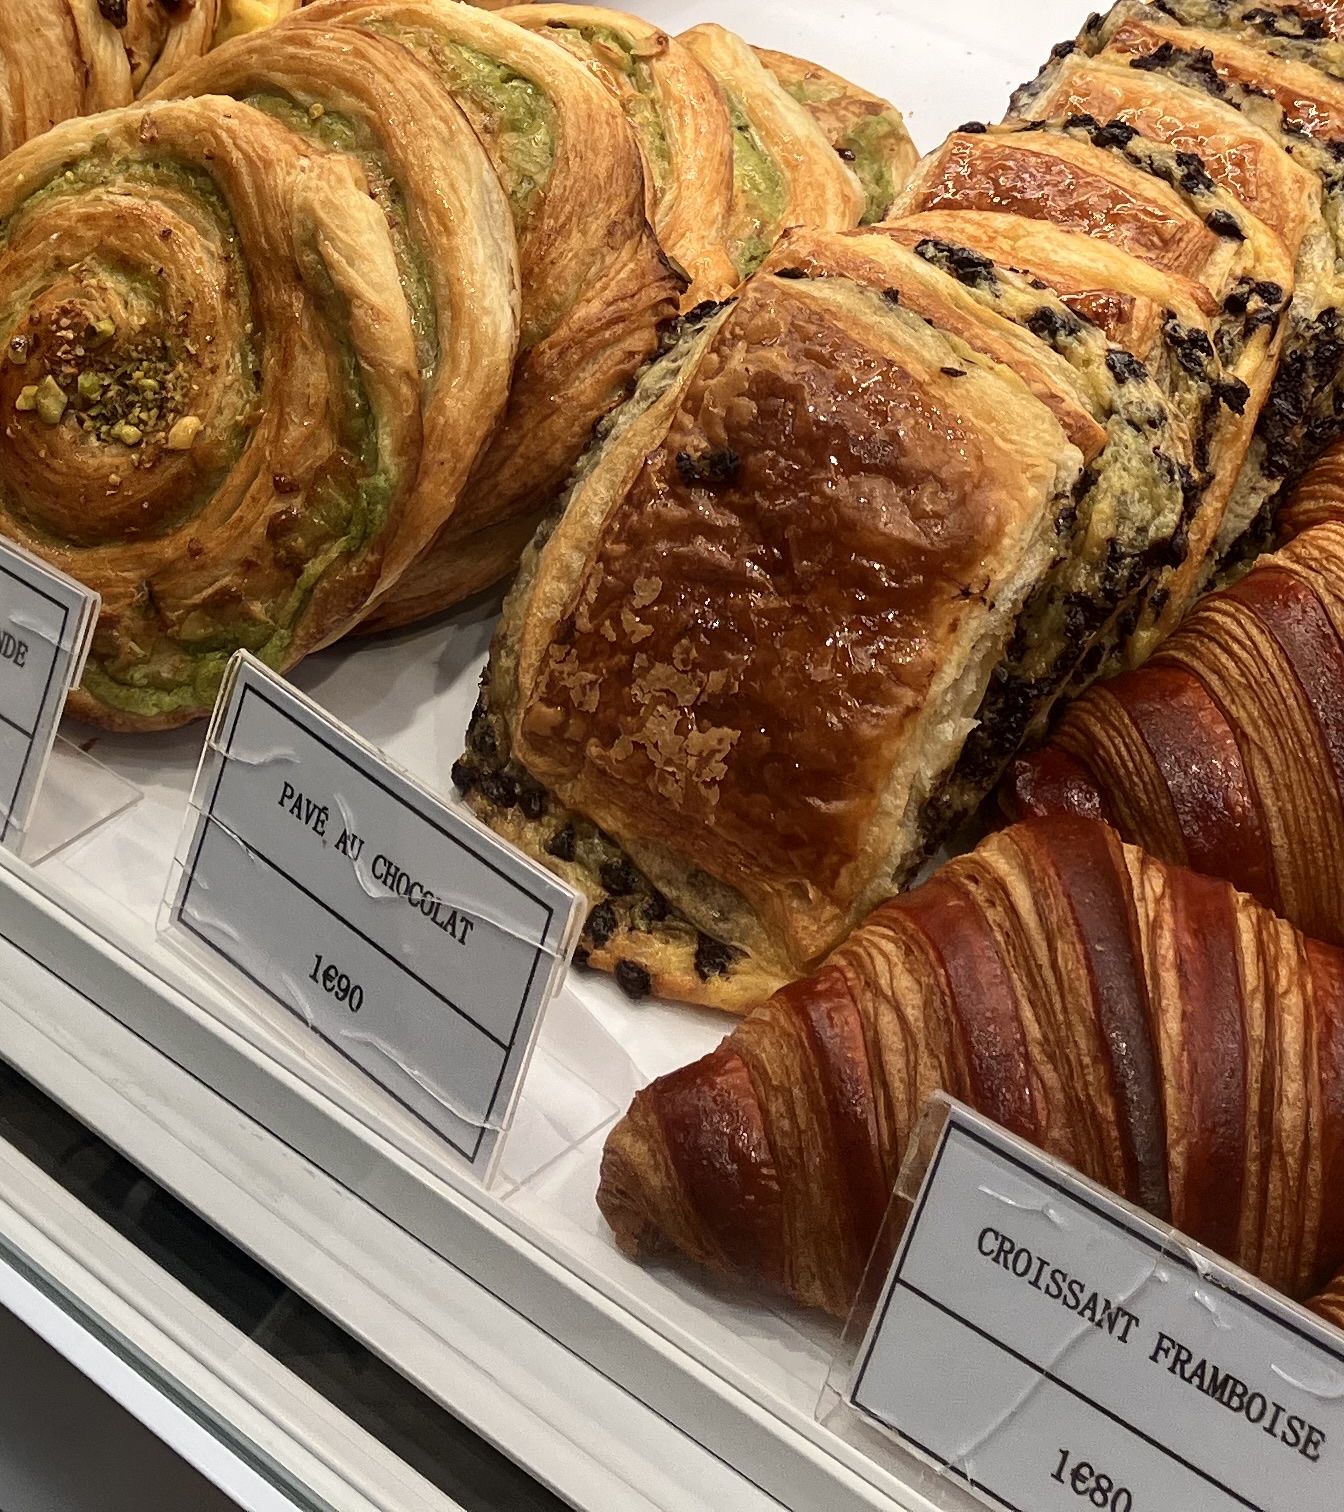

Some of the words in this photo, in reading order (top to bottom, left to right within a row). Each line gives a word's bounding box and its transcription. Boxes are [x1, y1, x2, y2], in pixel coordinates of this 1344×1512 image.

[278, 781, 330, 837] PAVÉ
[334, 828, 365, 862] AU
[371, 853, 475, 946] CHOCOLAT
[308, 954, 365, 1014] 1€90
[977, 1226, 1141, 1345] CROISSANT
[1148, 1331, 1327, 1463] FRAMBOISE
[1050, 1447, 1134, 1512] 1€80
